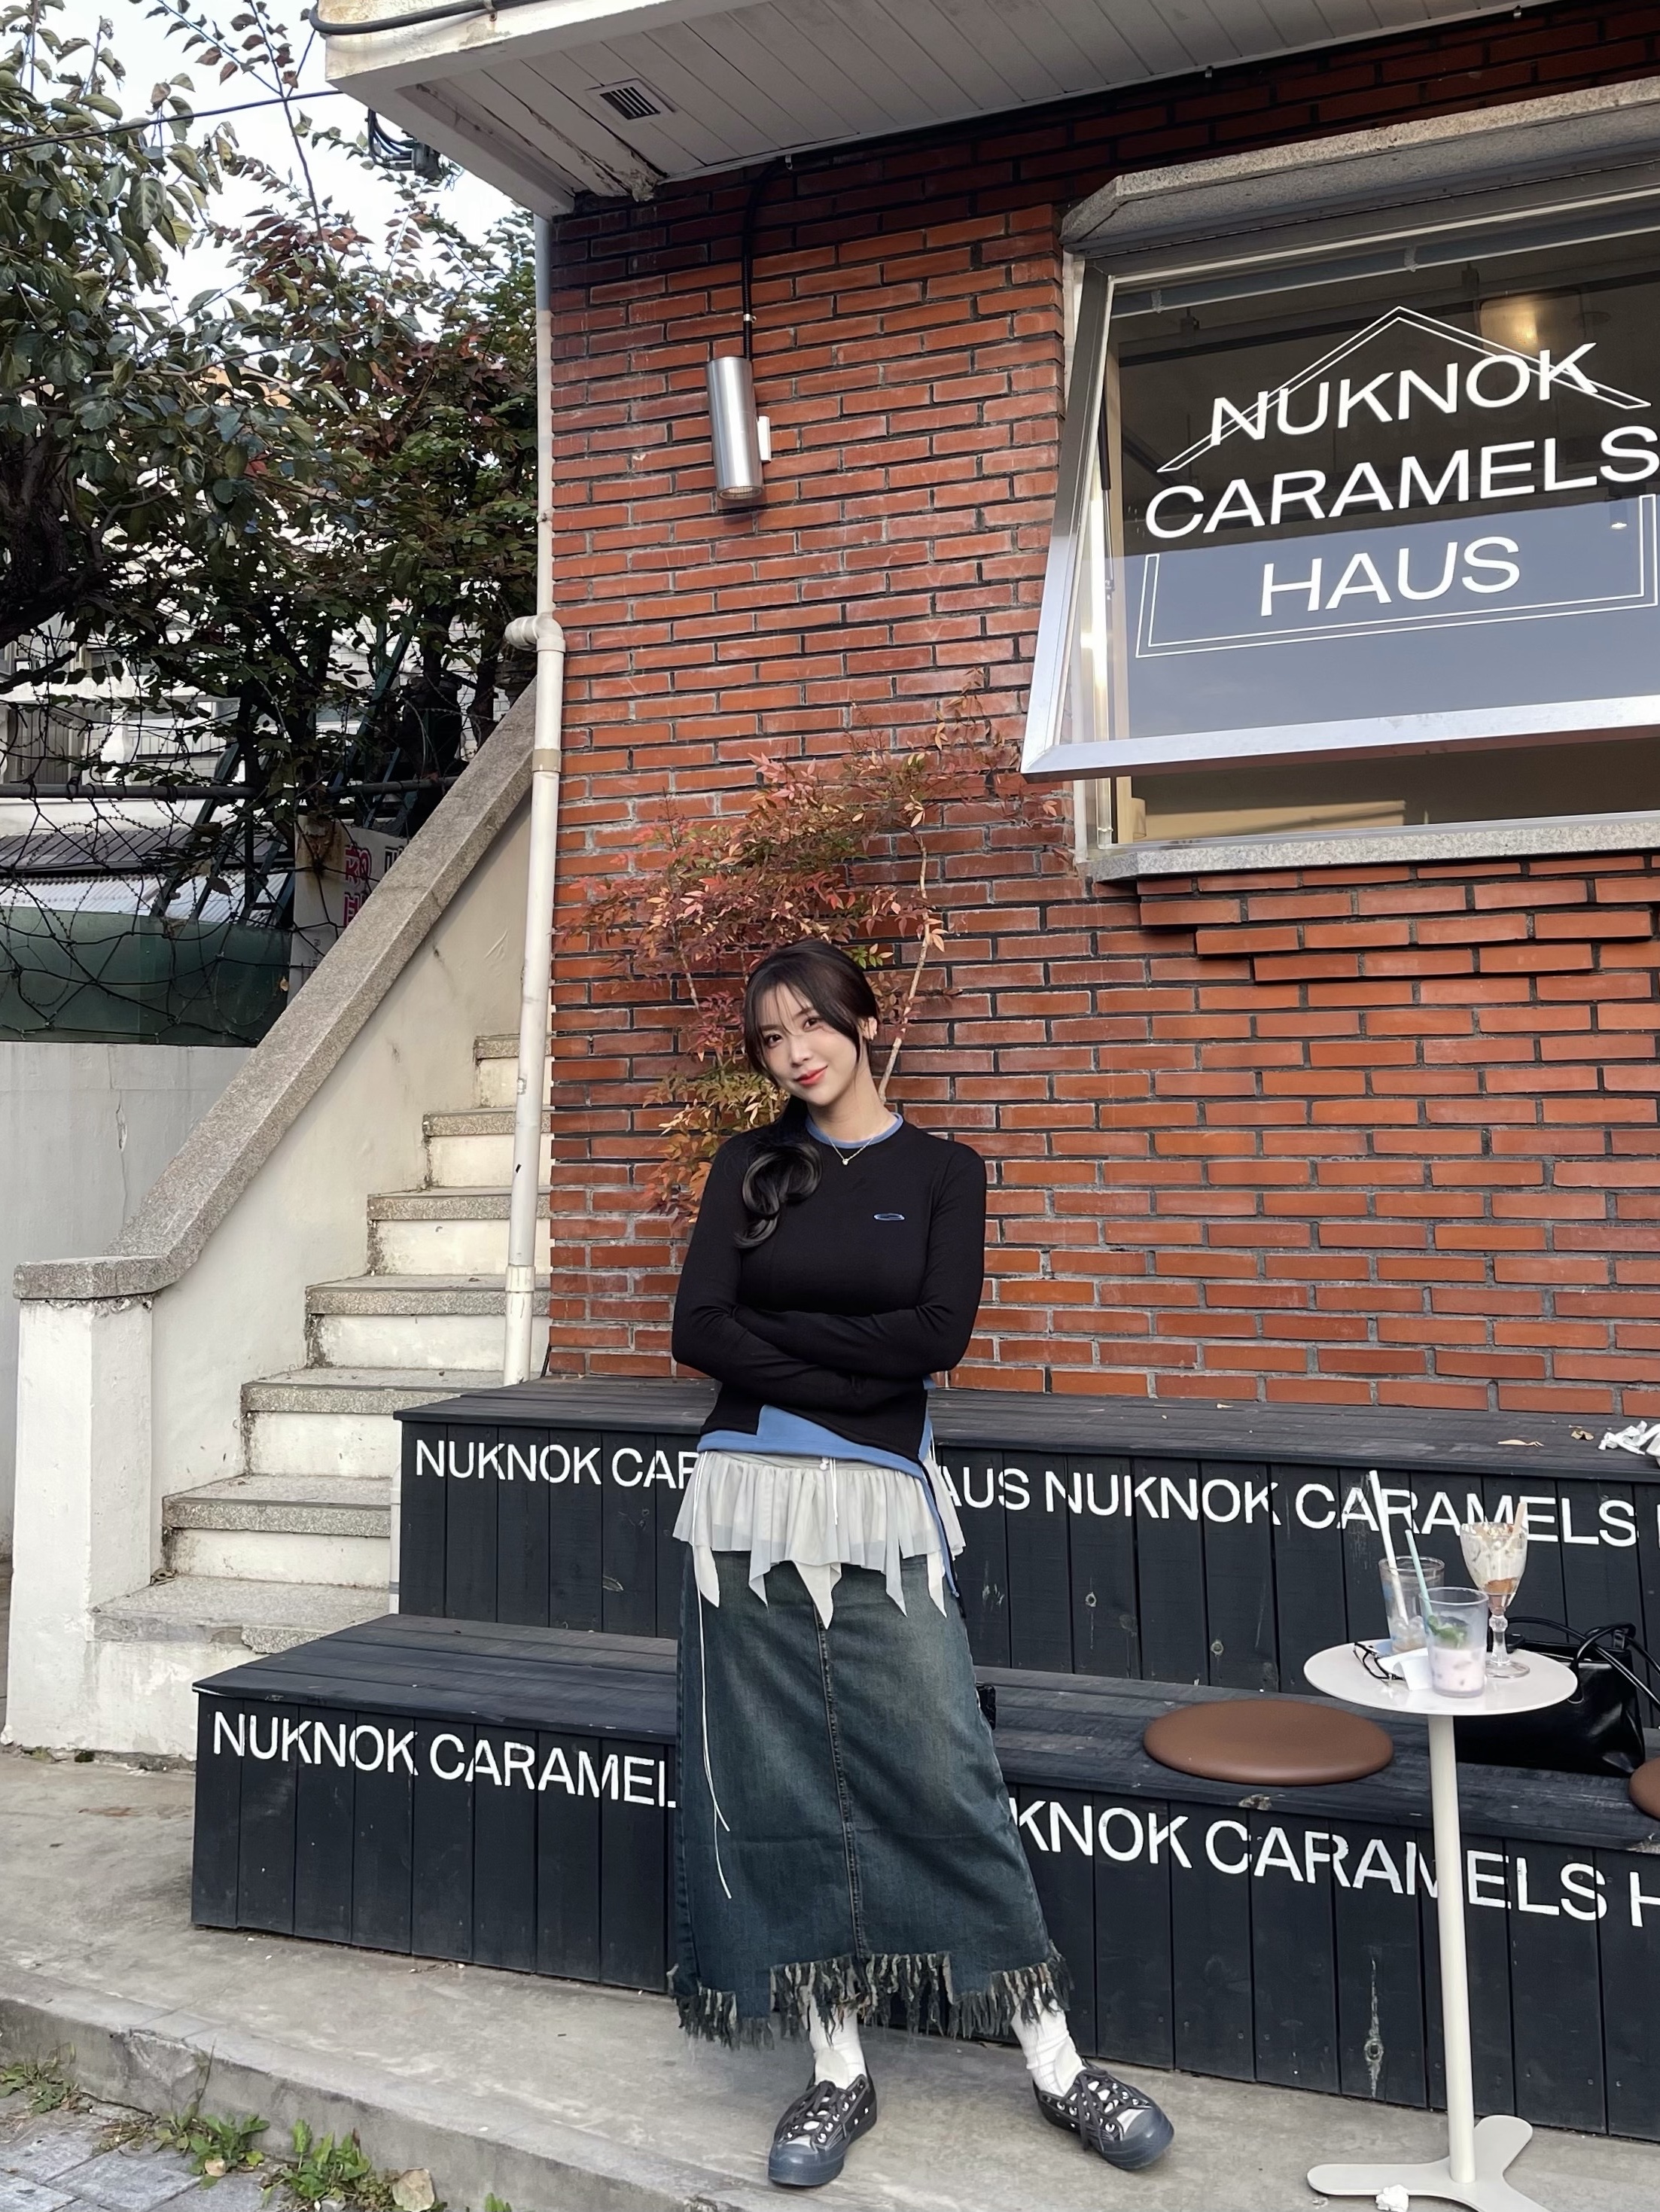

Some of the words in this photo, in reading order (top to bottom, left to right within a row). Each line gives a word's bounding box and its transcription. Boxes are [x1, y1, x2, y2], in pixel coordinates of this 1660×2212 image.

[1209, 342, 1598, 446] NUKNOK
[1145, 424, 1660, 539] CARAMELS
[1260, 535, 1521, 617] HAUS
[416, 1439, 602, 1486] NUKNOK
[1045, 1470, 1281, 1526] NUKNOK
[1295, 1482, 1640, 1548] CARAMELS
[213, 1711, 419, 1777] NUKNOK
[1205, 1819, 1608, 1921] CARAMELS
